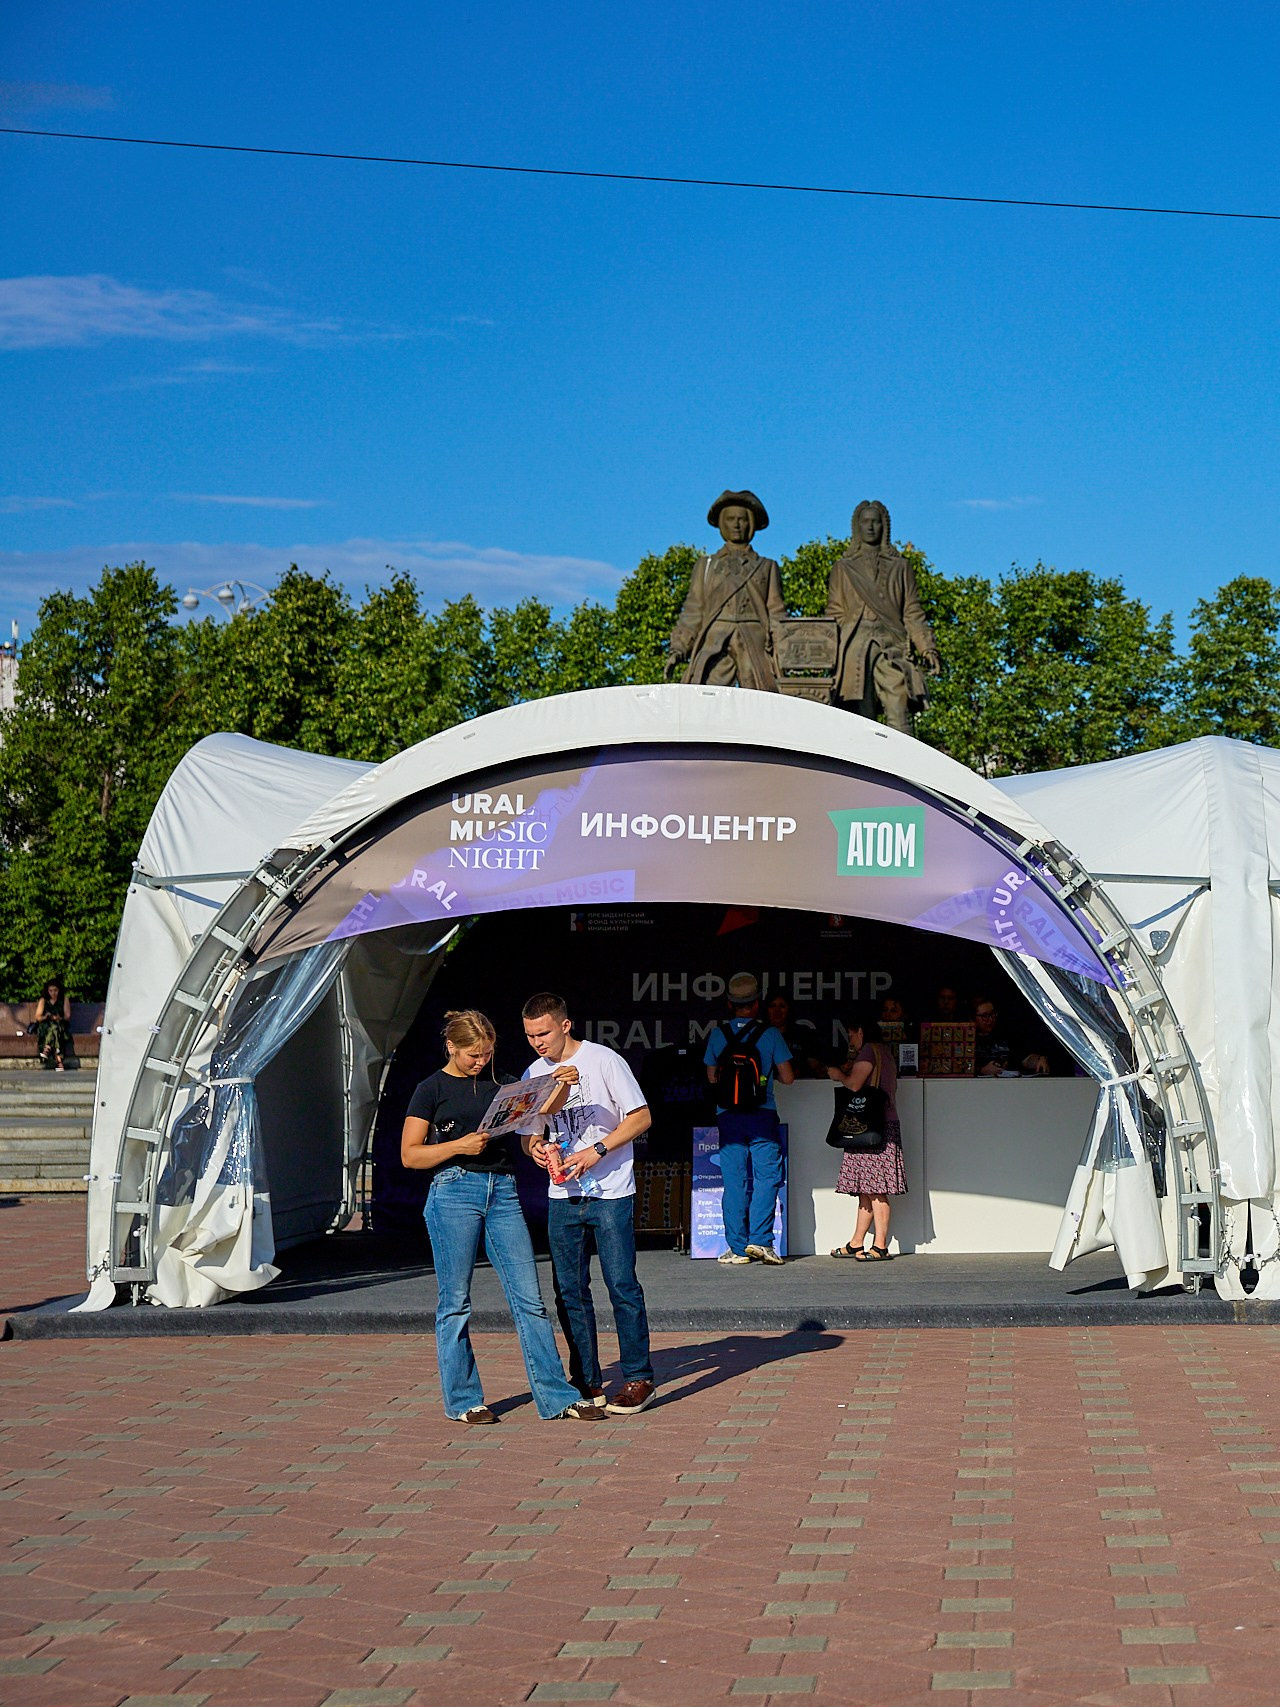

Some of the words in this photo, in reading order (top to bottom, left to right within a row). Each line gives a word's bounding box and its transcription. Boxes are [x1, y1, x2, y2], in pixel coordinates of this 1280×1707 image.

[452, 792, 535, 816] URAL
[450, 819, 548, 844] MUSIC
[580, 812, 798, 845] ИНФОЦЕНТР
[846, 821, 916, 868] АТОМ
[448, 847, 545, 870] NIGHT
[556, 877, 625, 904] MUSIC
[587, 911, 645, 919] ПРЕЗИДЕНТСКИЙ
[1014, 899, 1056, 948] RAL
[632, 971, 893, 1002] ИНФЦЕНТР
